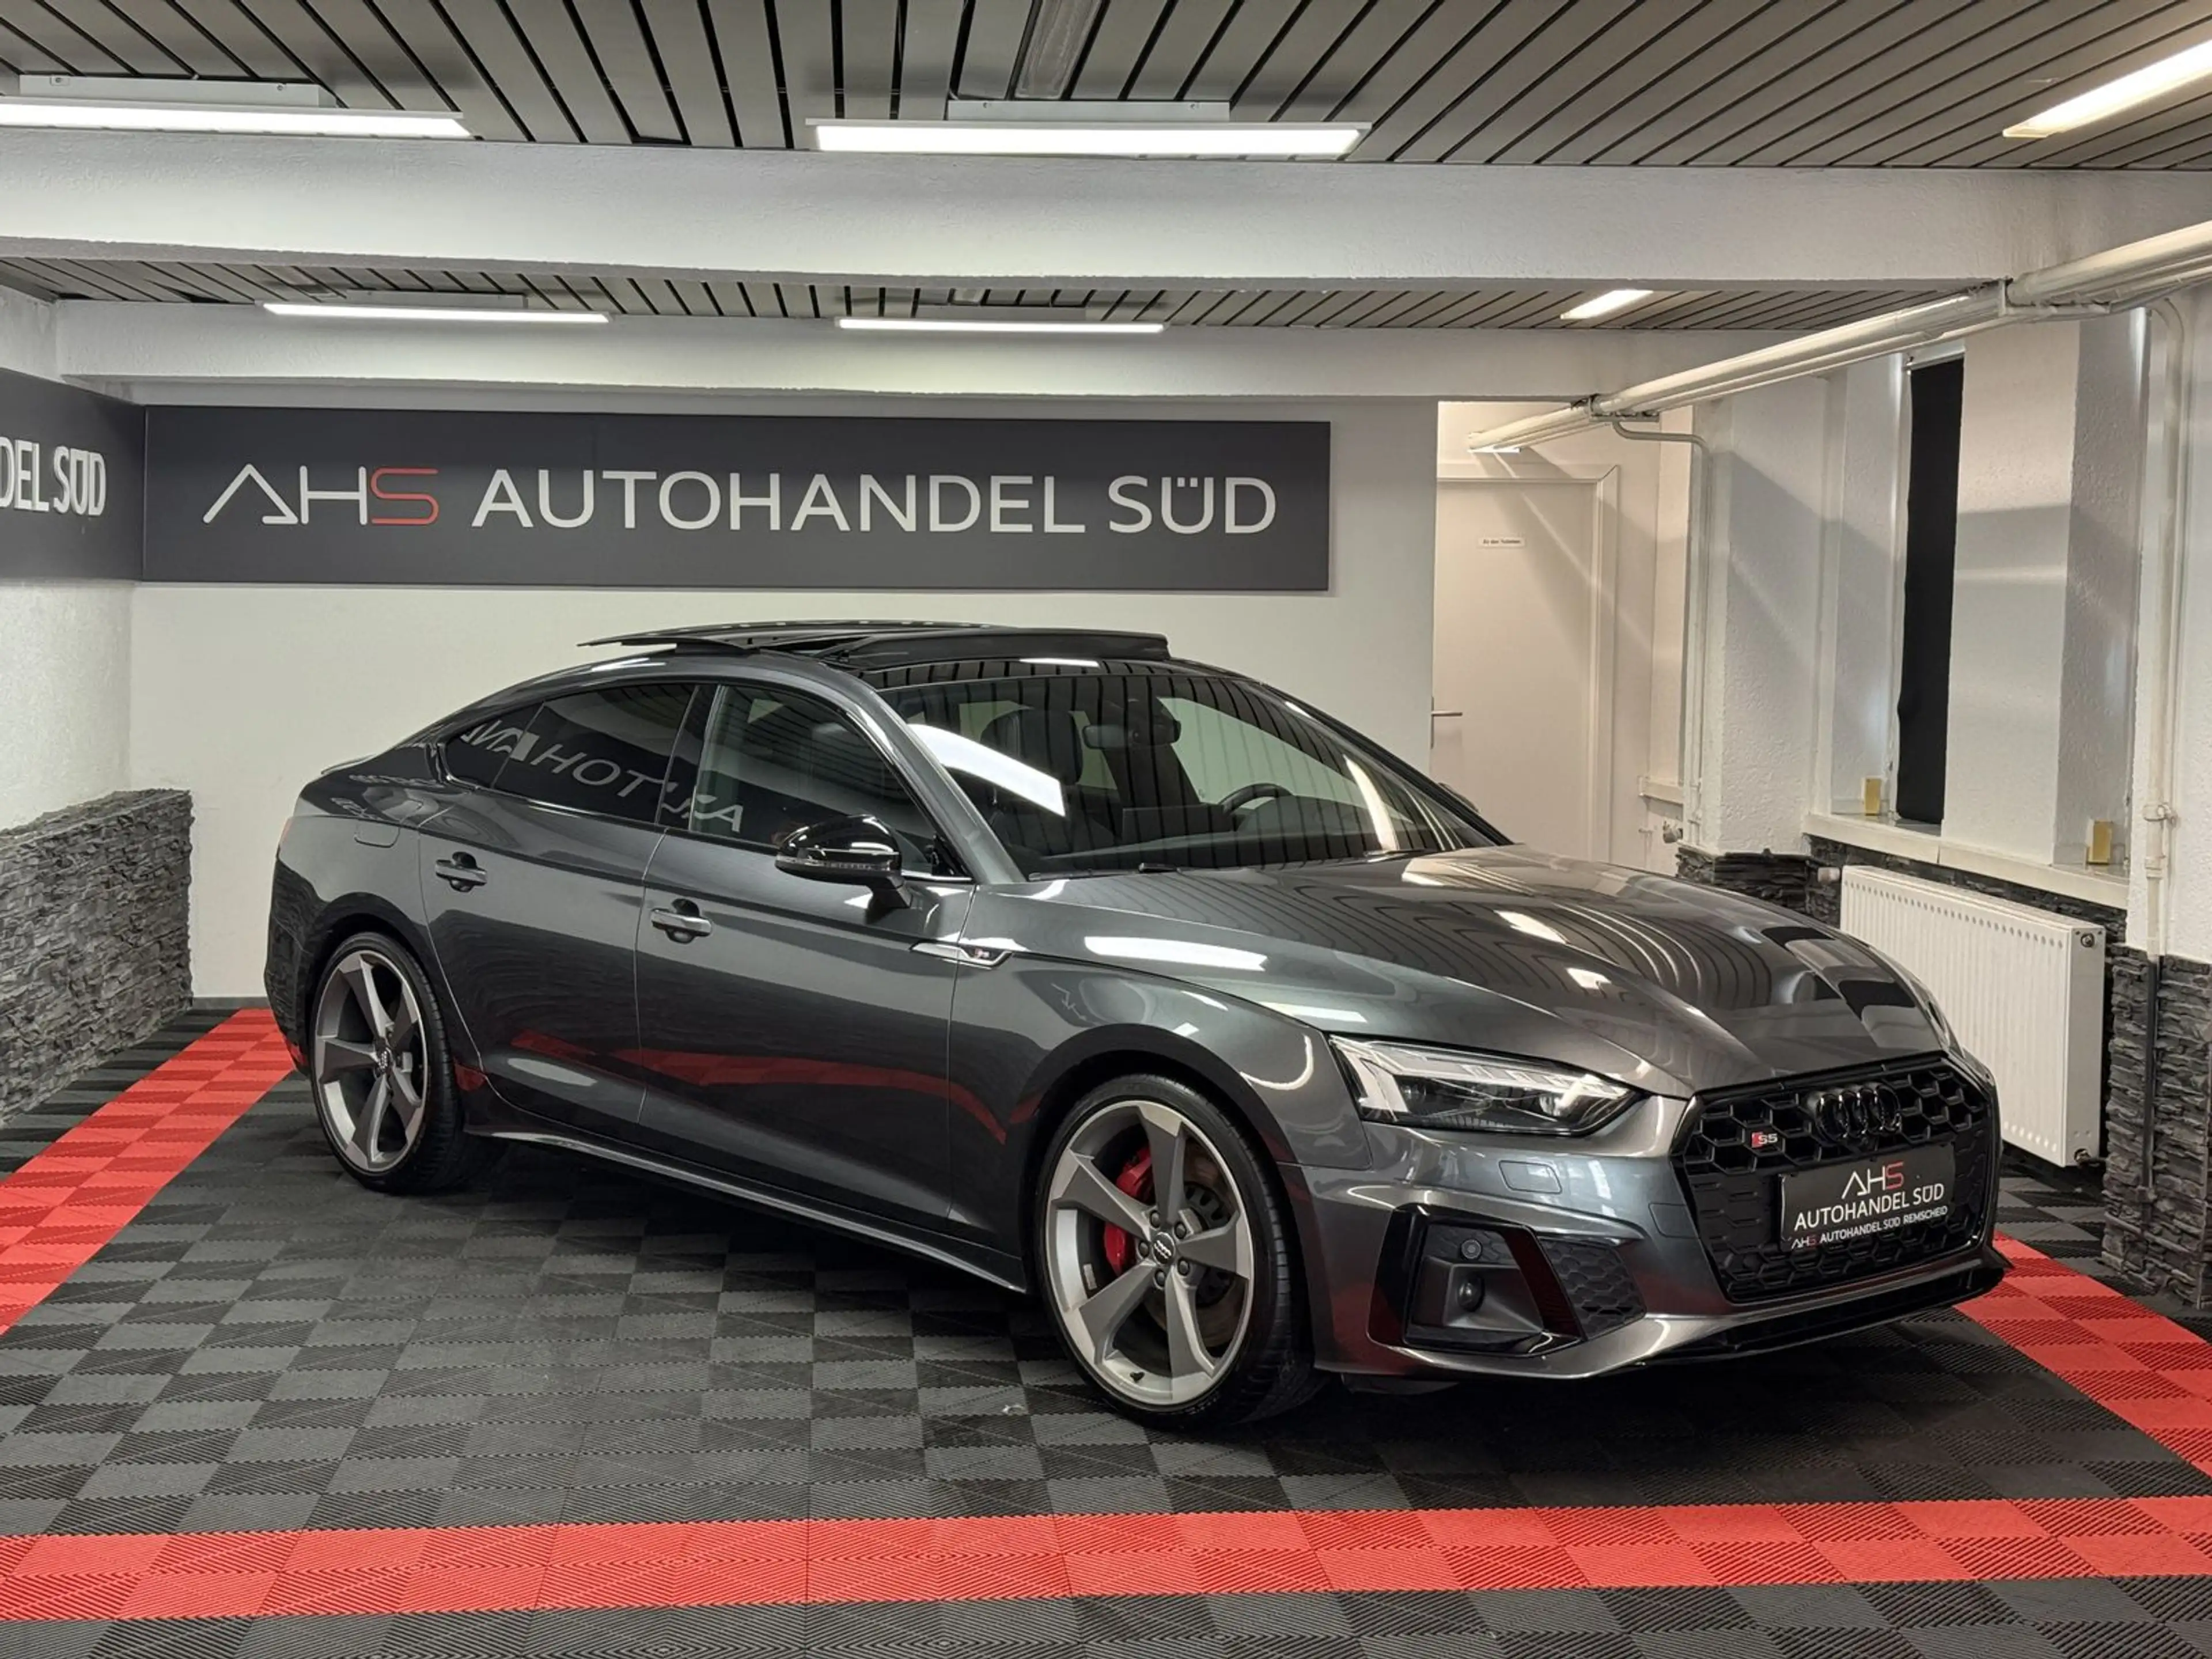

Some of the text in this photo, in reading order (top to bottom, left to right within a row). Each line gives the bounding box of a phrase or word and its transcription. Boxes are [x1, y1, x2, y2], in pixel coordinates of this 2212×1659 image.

[203, 463, 1276, 534] AHS AUTOHANDEL SÜD
[1758, 1133, 1778, 1145] S5
[1842, 1161, 1904, 1199] AHS
[1794, 1183, 1945, 1232] AUTOHANDEL SÜD
[1819, 1221, 1883, 1244] AUTOHANDEL
[1903, 1205, 1948, 1225] REMSCHEID
